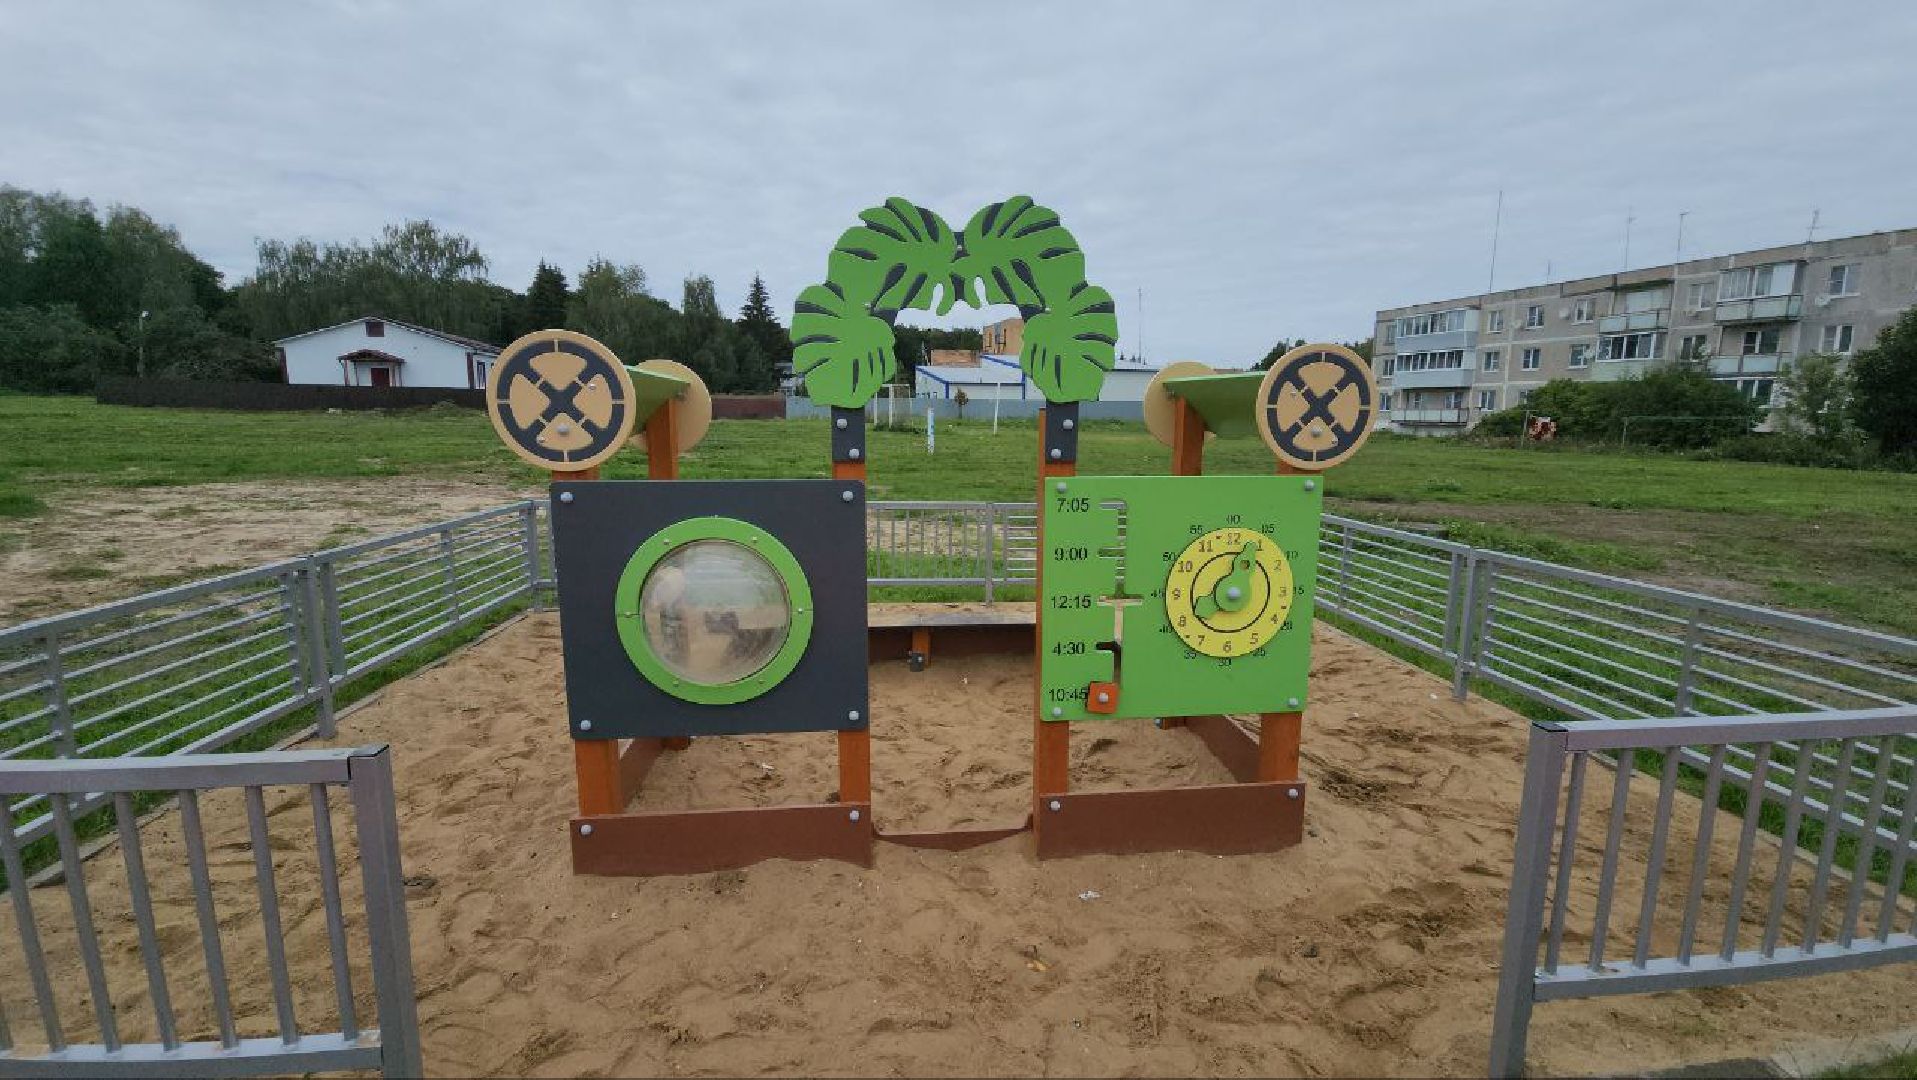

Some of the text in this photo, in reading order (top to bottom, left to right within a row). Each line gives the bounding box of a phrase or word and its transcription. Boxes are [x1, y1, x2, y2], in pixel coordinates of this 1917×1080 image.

[1056, 498, 1089, 512] 7:05
[1199, 540, 1213, 552] 11
[1054, 548, 1088, 561] 9:00
[1178, 560, 1193, 572] 10
[1273, 560, 1282, 571] 2
[1172, 588, 1181, 600] 9
[1051, 596, 1092, 609] 12:15
[1178, 614, 1186, 627] 8
[1271, 614, 1279, 624] 4
[1198, 634, 1205, 646] 7
[1250, 632, 1259, 645] 5
[1053, 642, 1085, 655] 4:30
[1223, 640, 1232, 653] 6
